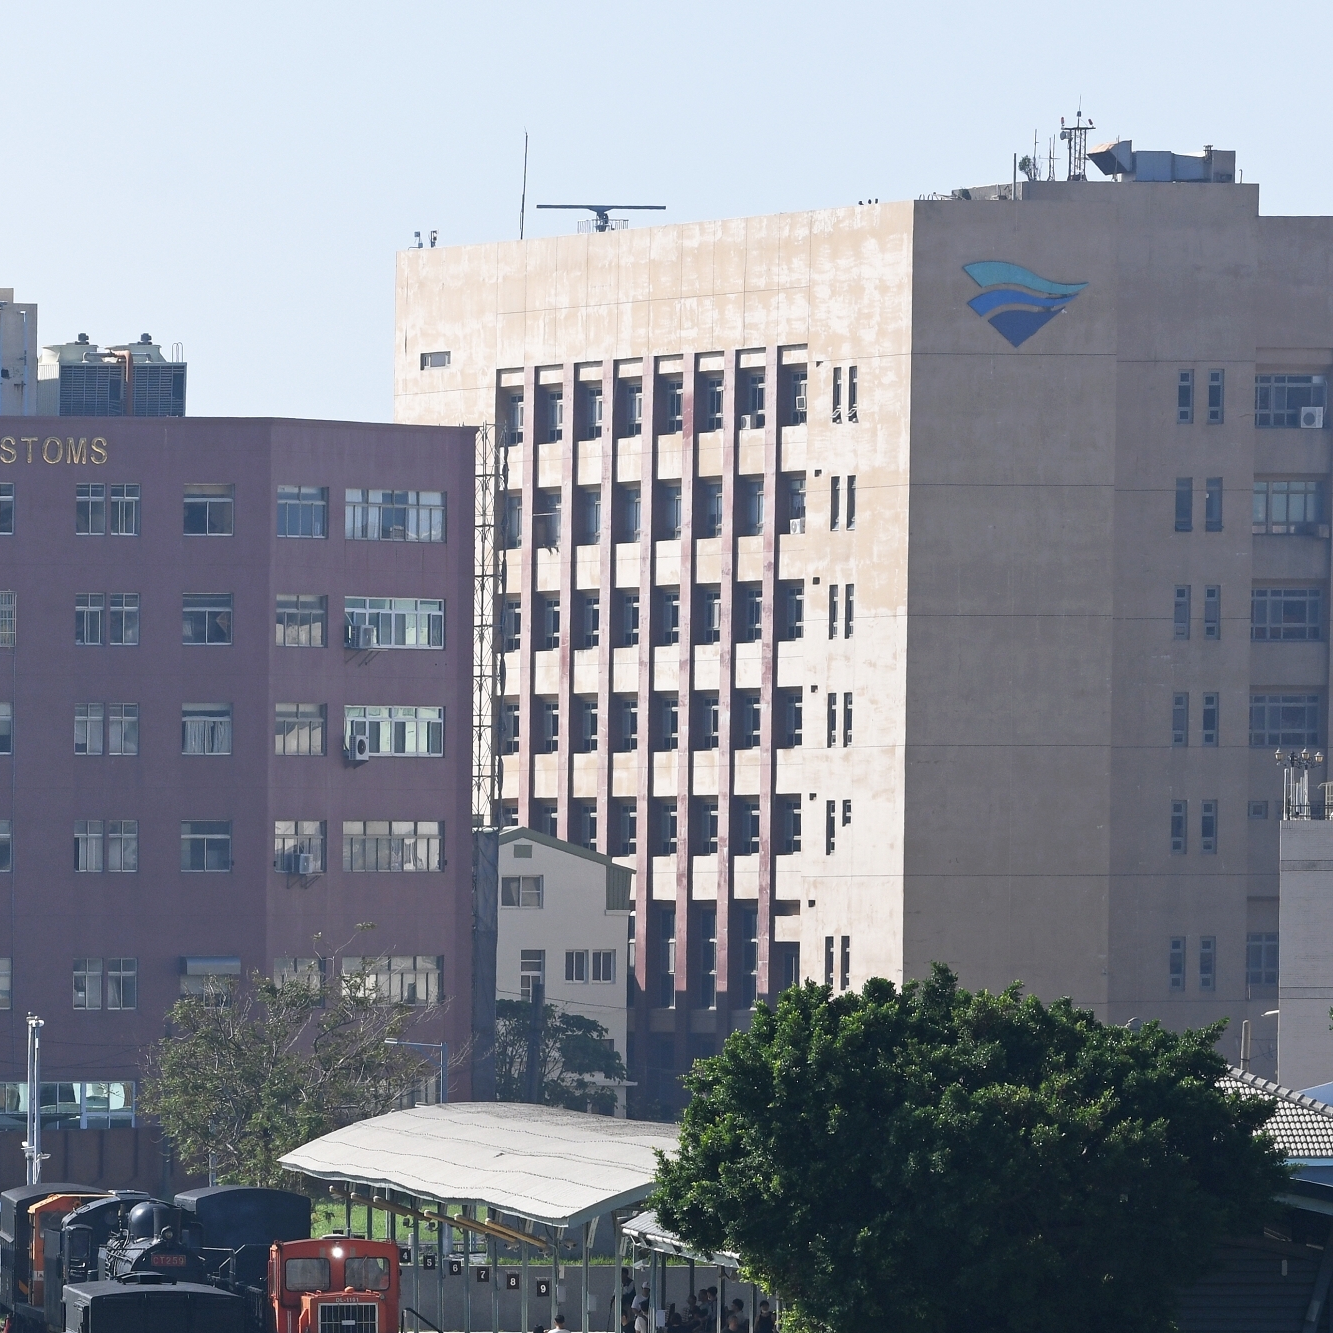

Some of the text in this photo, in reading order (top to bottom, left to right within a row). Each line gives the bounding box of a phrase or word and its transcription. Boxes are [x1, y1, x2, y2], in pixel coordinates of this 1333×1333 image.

[402, 1251, 408, 1260] 4
[153, 1256, 184, 1265] CT259
[426, 1258, 432, 1267] 5
[452, 1264, 458, 1272] 6
[480, 1270, 486, 1279] 7
[510, 1277, 516, 1286] 8
[540, 1284, 546, 1293] 9
